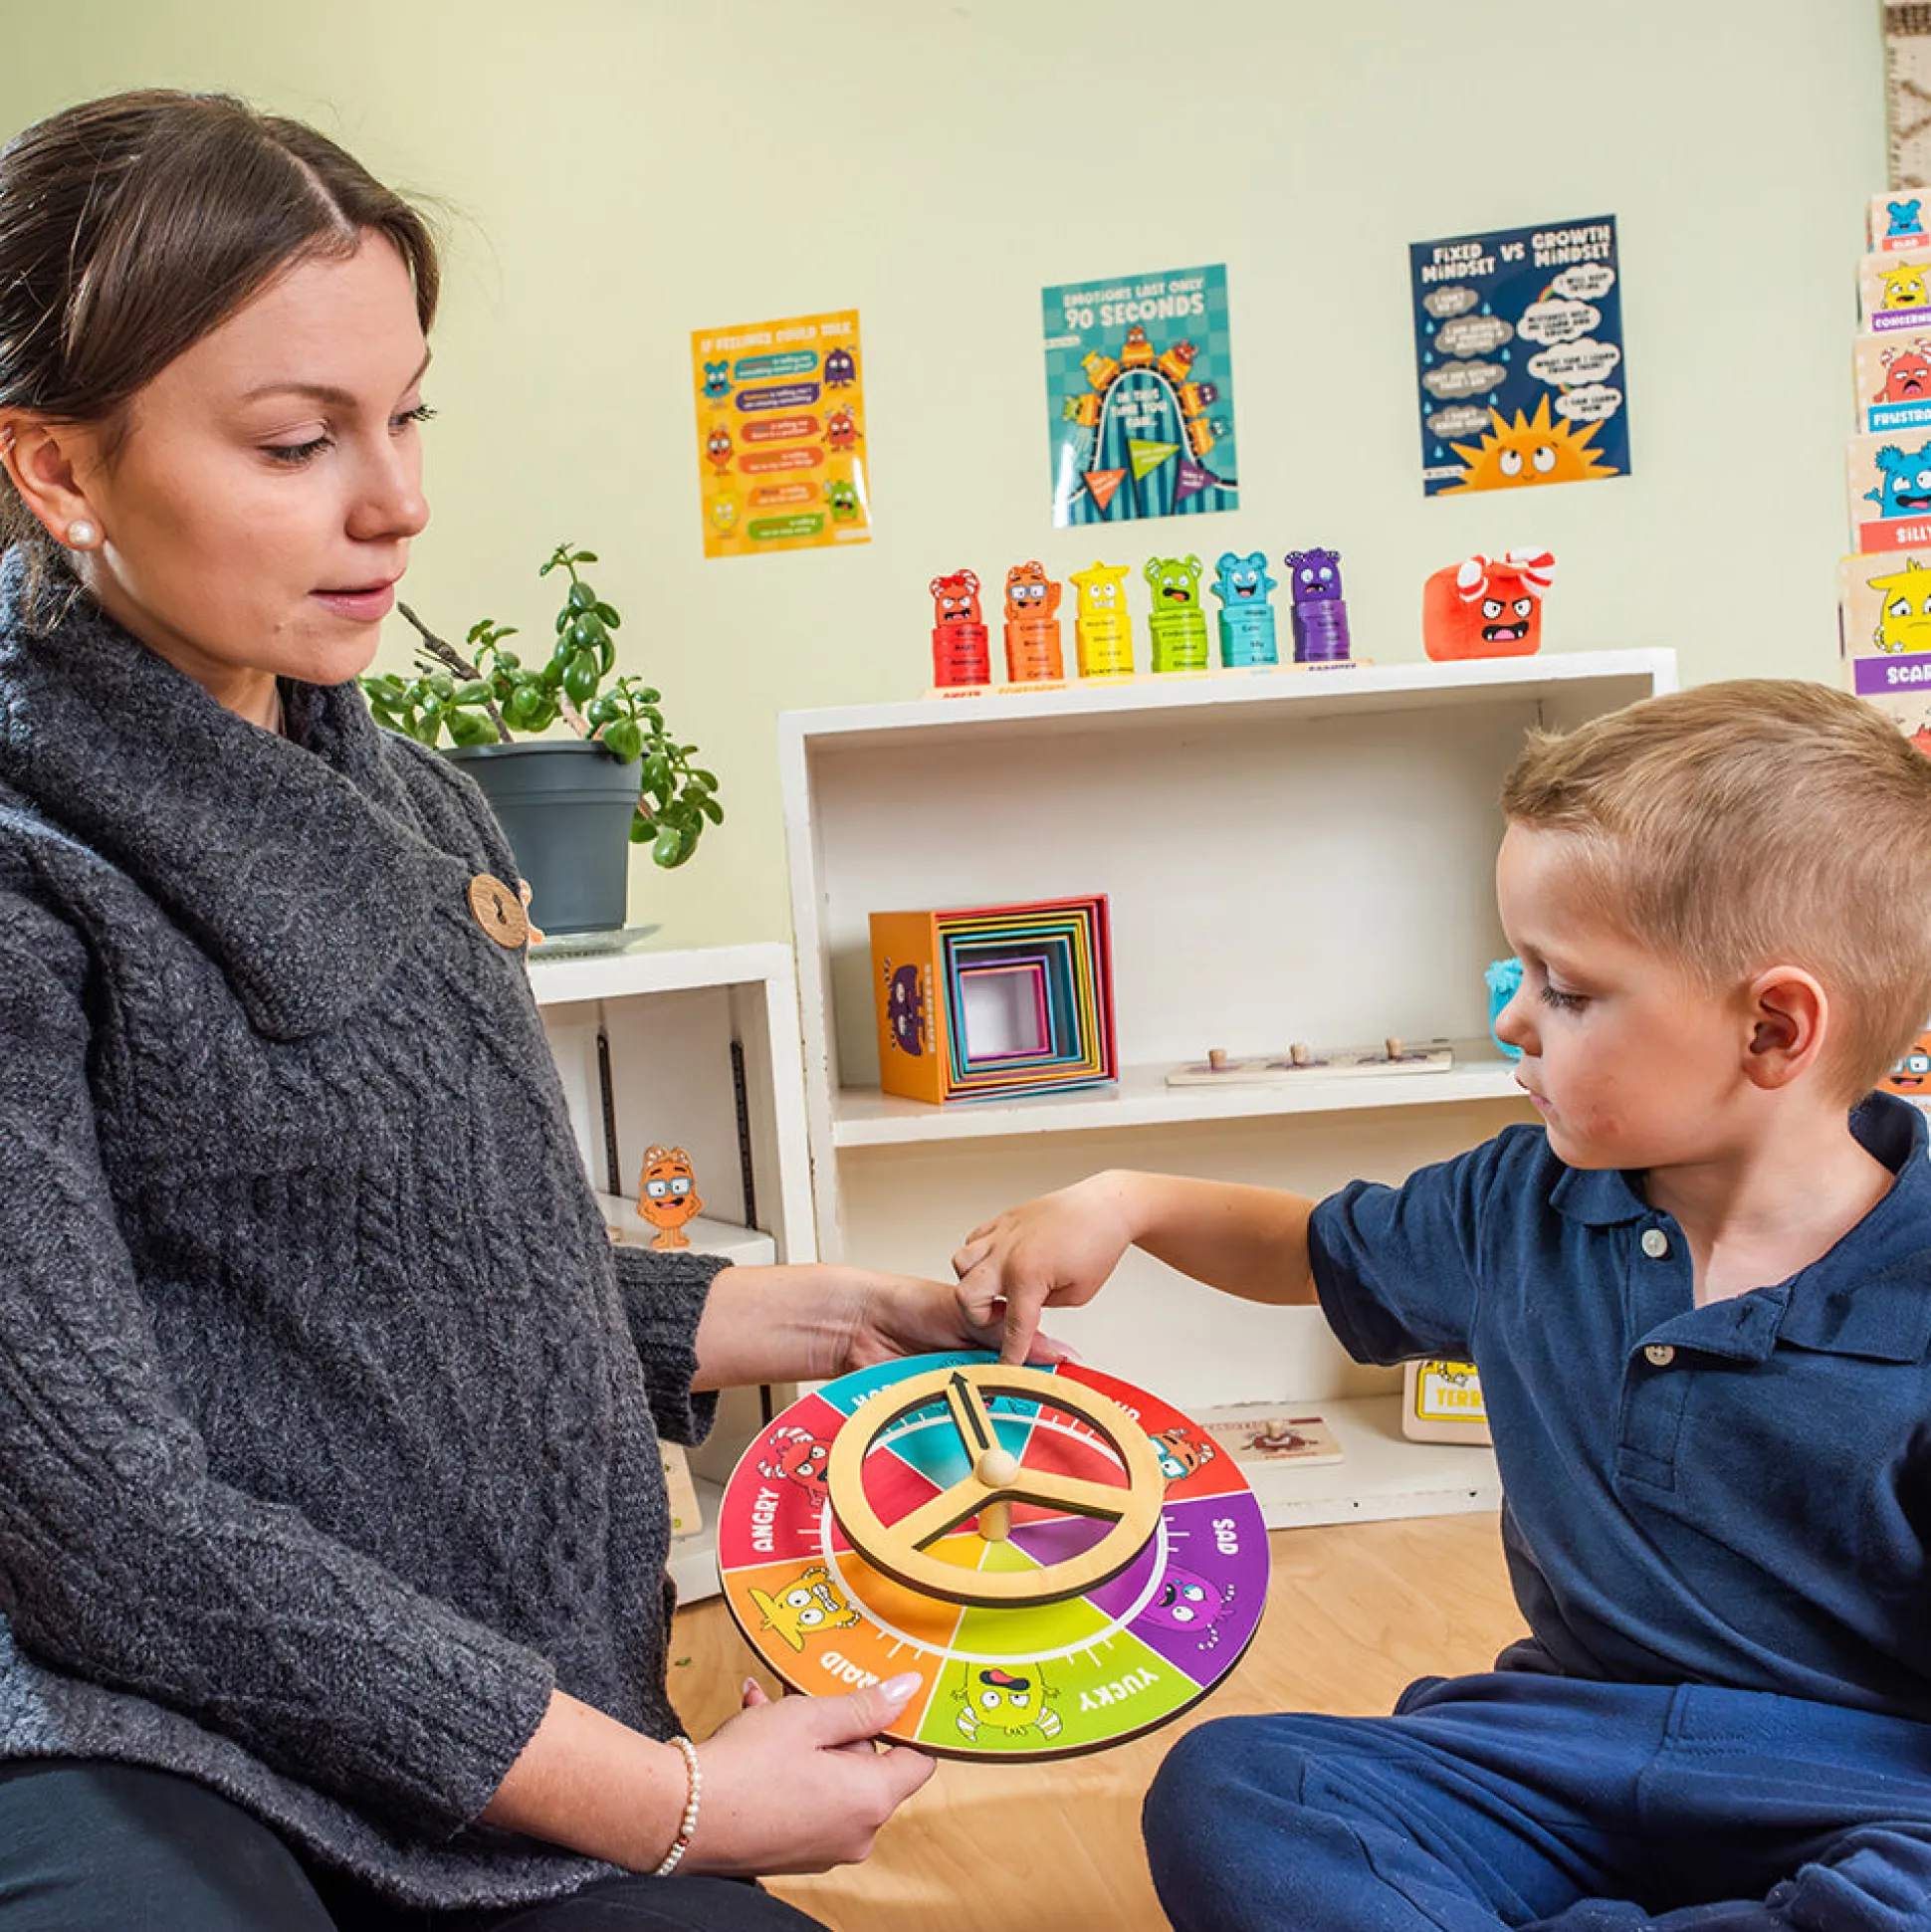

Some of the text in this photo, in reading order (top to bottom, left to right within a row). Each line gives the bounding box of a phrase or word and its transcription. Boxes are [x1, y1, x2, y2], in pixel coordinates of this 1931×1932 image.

[1500, 242, 1526, 263] VS
[1533, 226, 1611, 249] GROWTH
[1421, 256, 1496, 284] MINDSET
[1433, 243, 1483, 265] FIXED
[1535, 242, 1609, 268] MINDSET
[1065, 293, 1204, 329] 90 SECONDS
[751, 1486, 778, 1551] ANGRY
[1212, 1518, 1238, 1554] SAD
[822, 1651, 880, 1689] RAID
[1079, 1667, 1159, 1711] YUCKY
